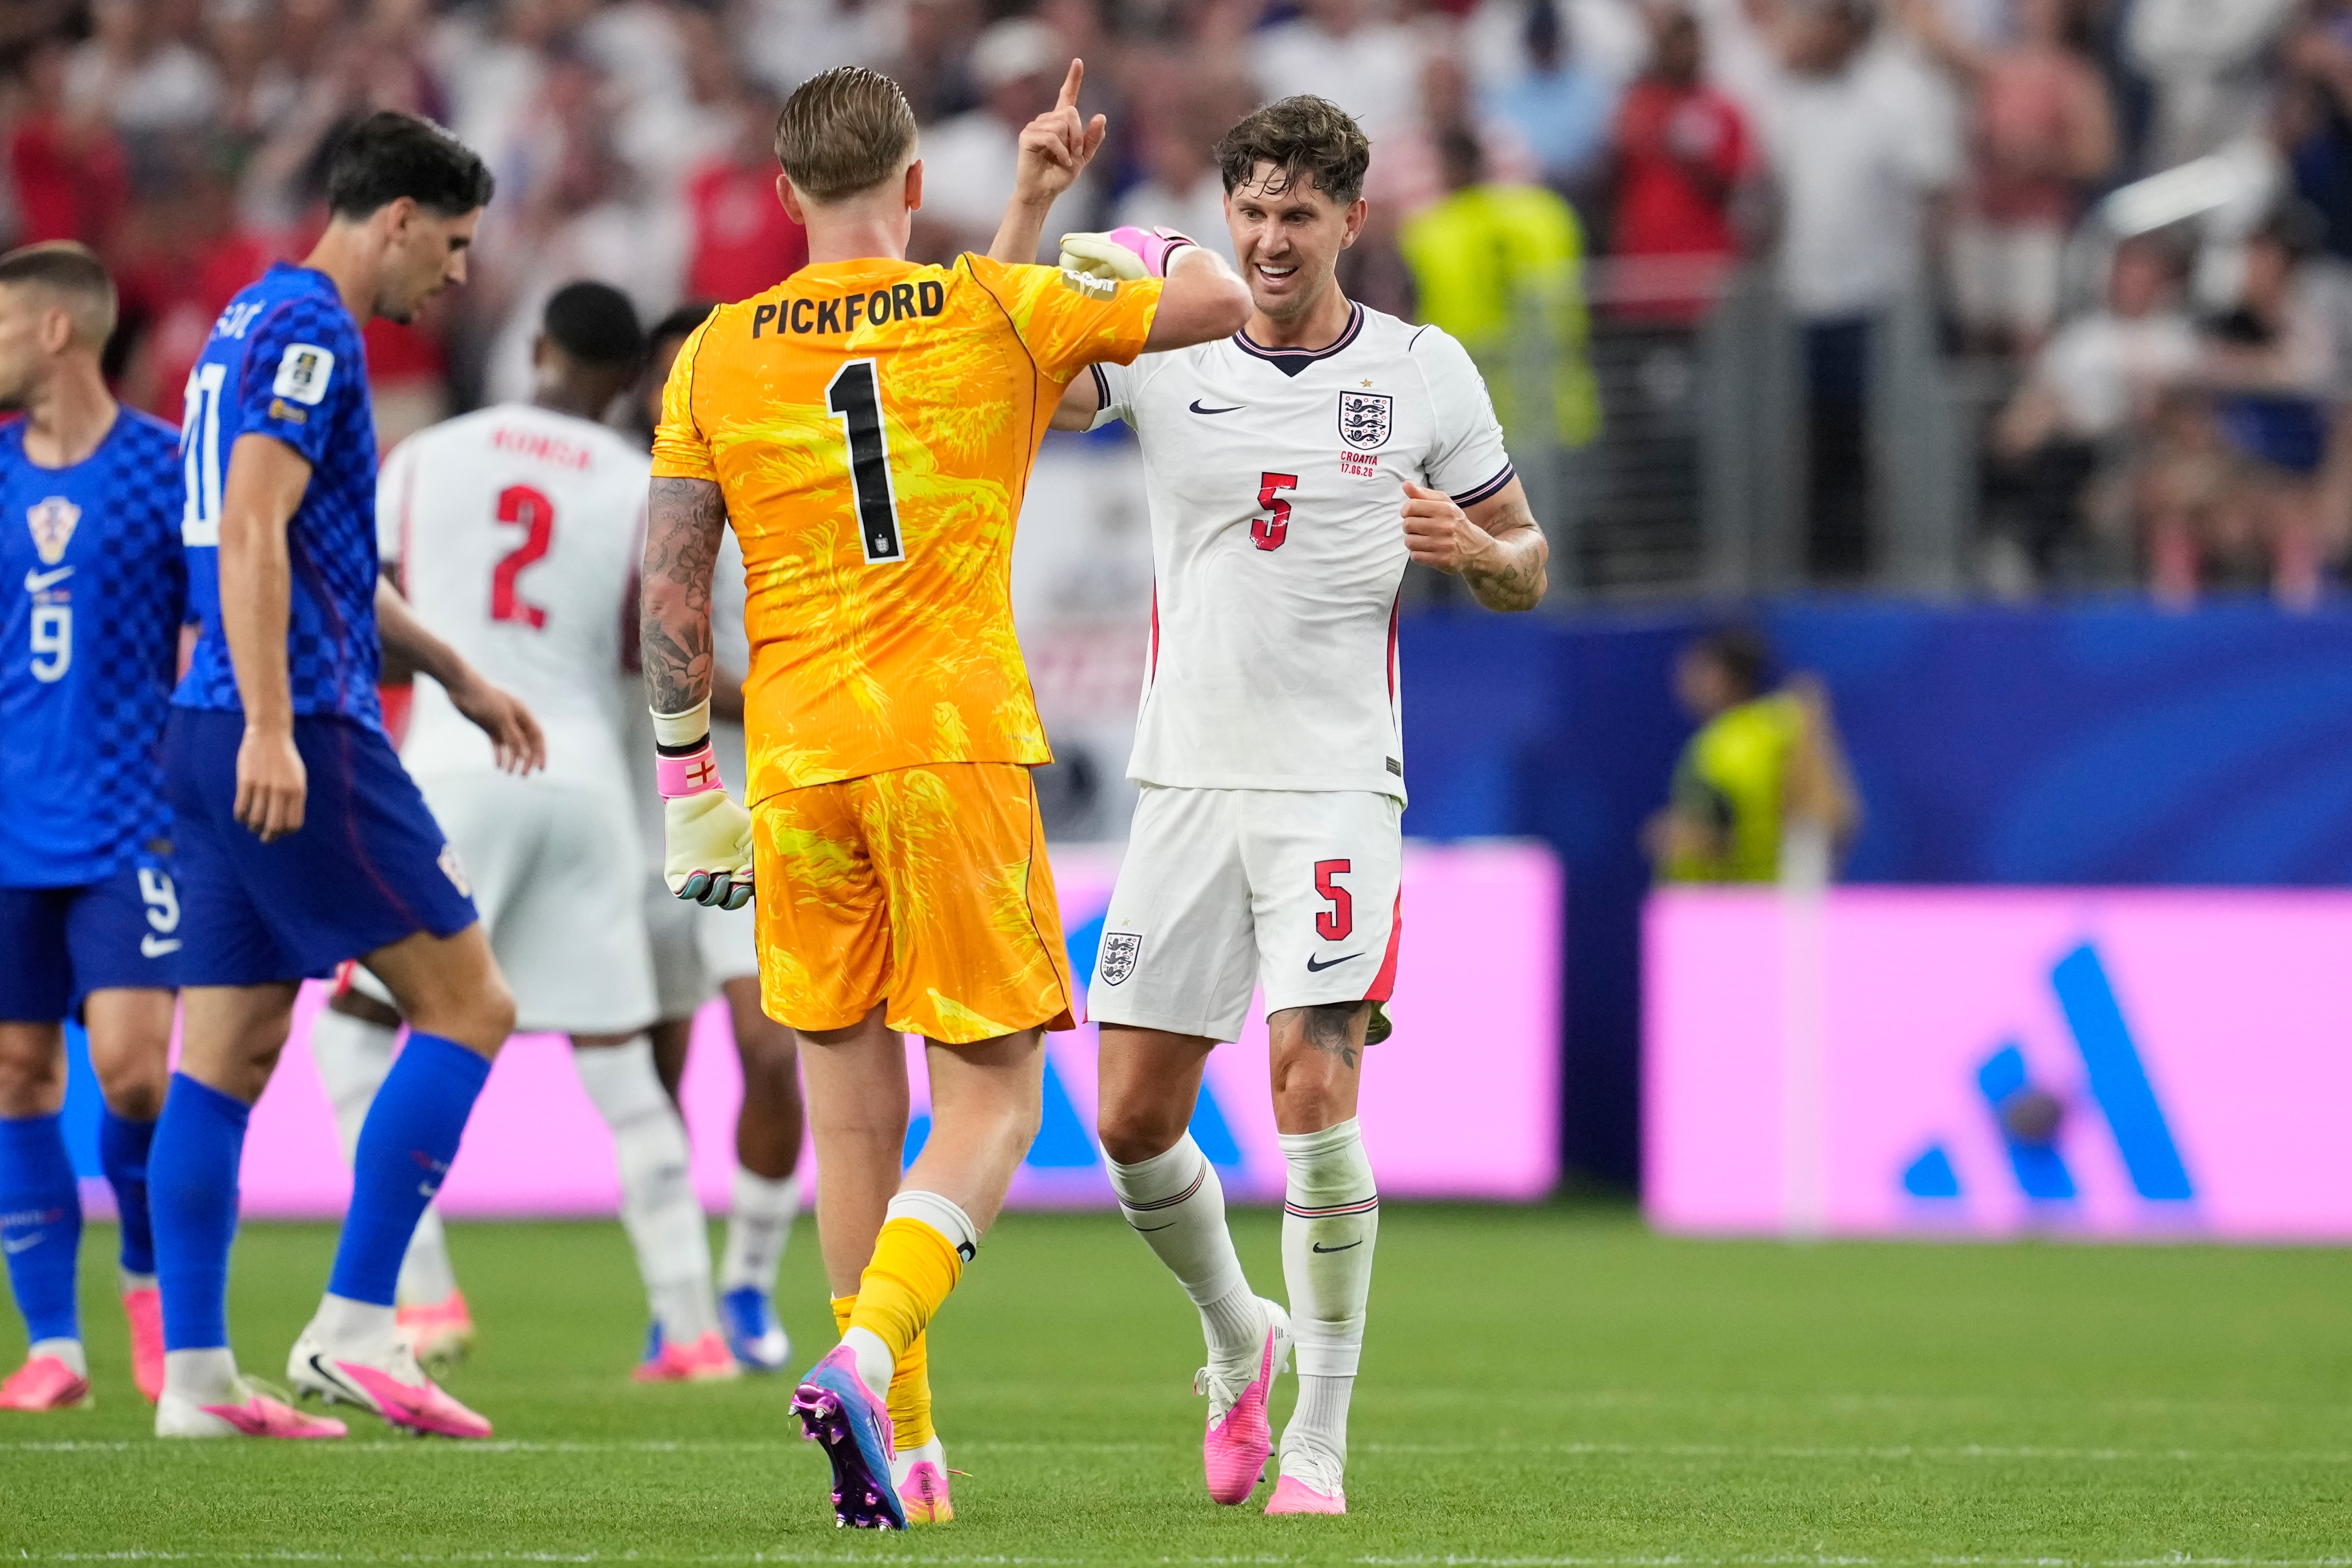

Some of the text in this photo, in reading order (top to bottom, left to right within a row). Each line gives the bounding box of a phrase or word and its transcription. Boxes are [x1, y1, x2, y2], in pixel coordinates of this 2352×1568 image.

[753, 280, 944, 339] PICKFORD
[824, 357, 905, 565] 1
[1341, 451, 1377, 465] CROATIA
[1341, 463, 1373, 477] 17.06.26
[1249, 471, 1298, 552] 5
[493, 484, 553, 630] 2
[30, 604, 73, 683] 9
[137, 867, 181, 933] 9
[1314, 859, 1352, 941] 5
[922, 1480, 935, 1505] ULTRA
